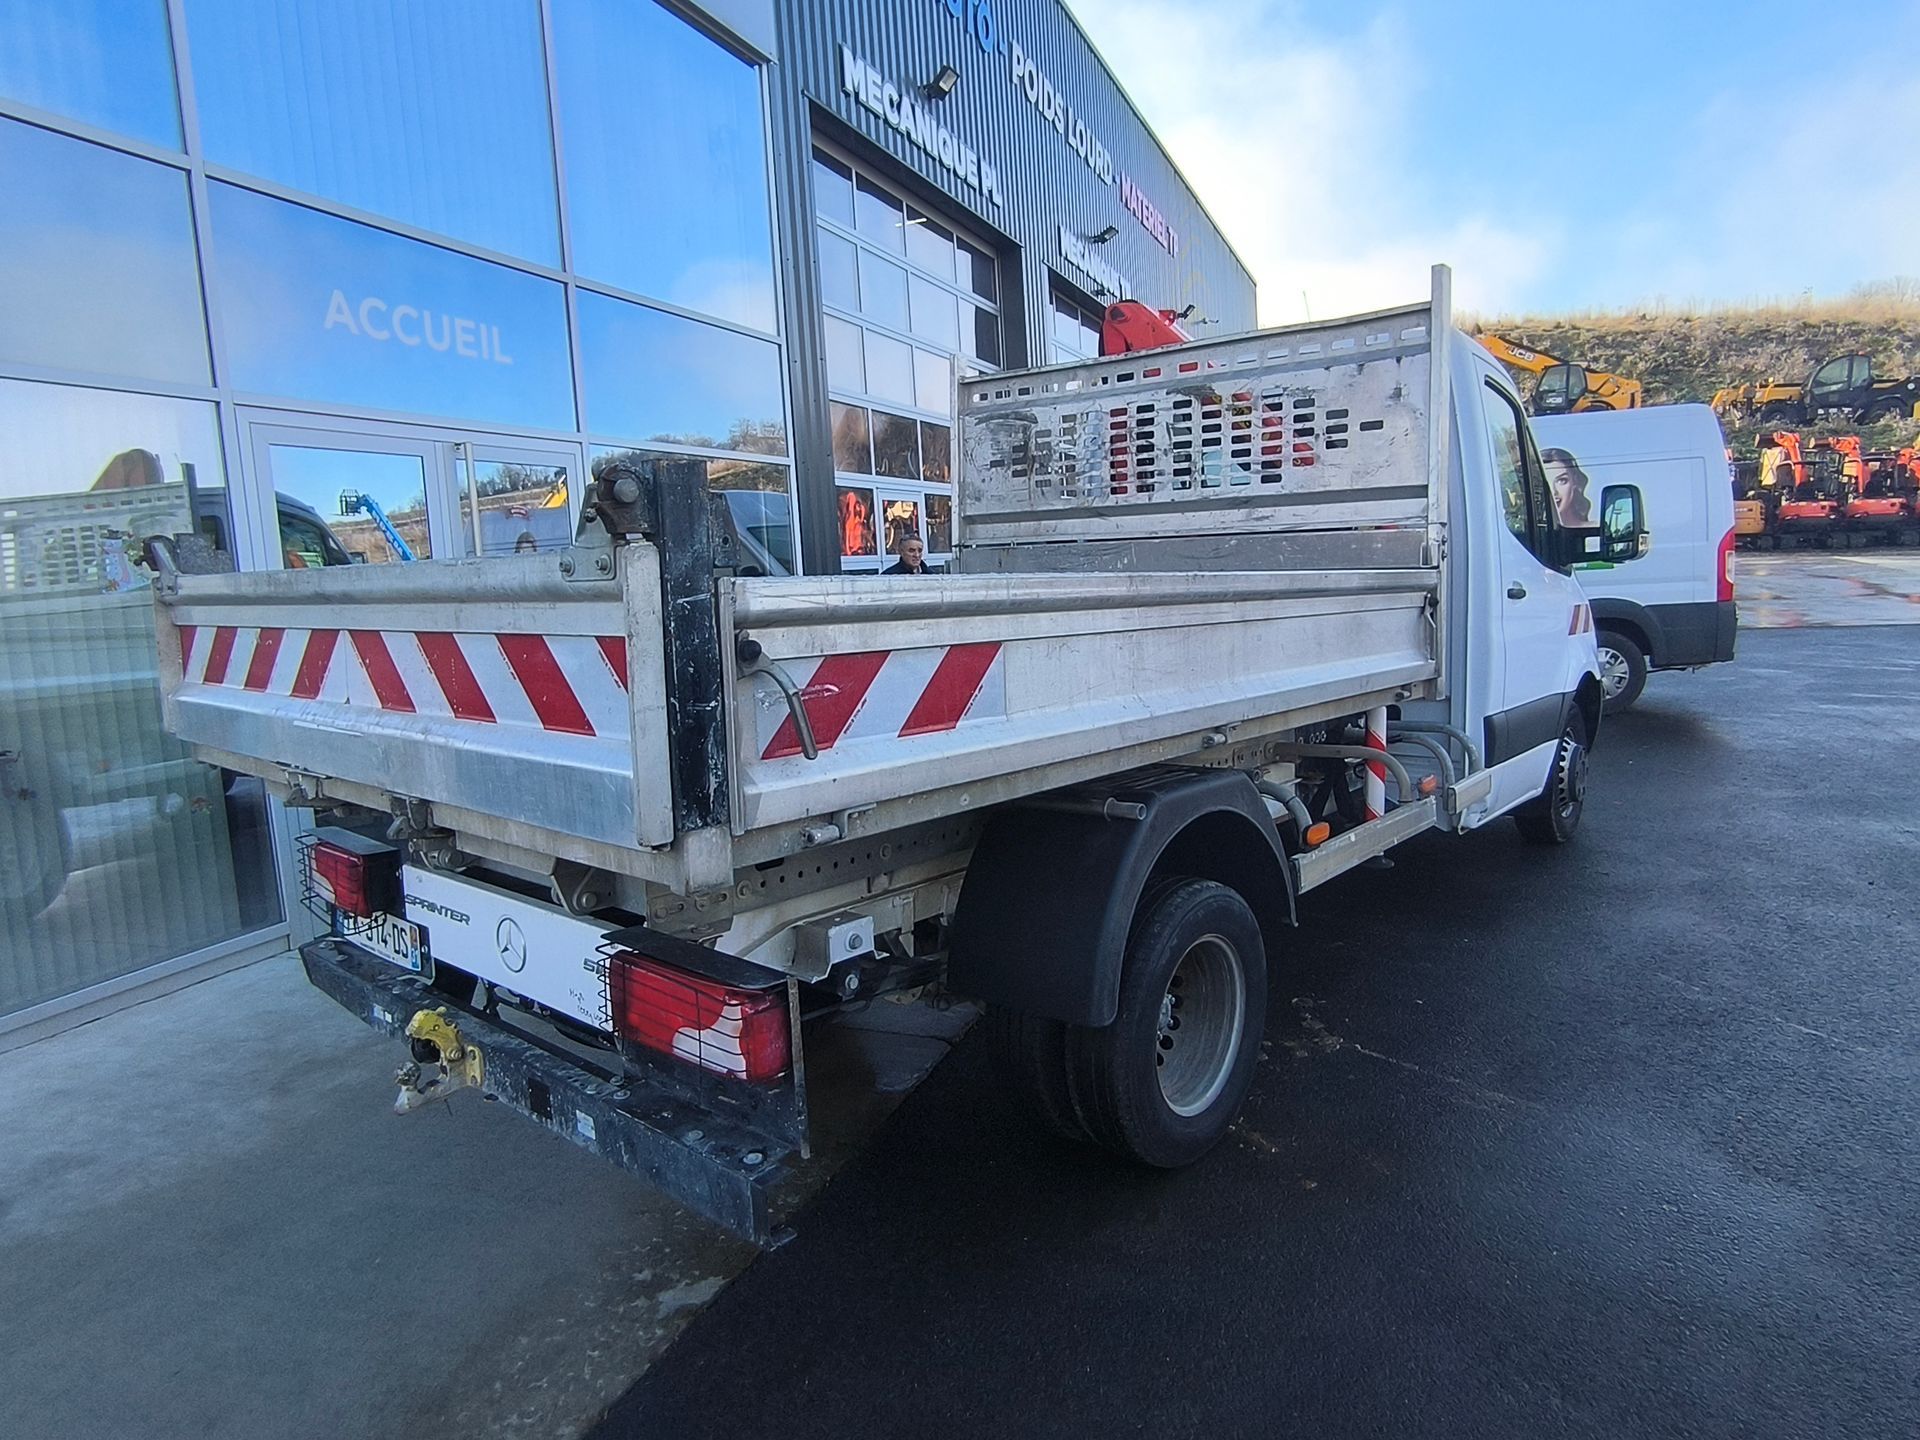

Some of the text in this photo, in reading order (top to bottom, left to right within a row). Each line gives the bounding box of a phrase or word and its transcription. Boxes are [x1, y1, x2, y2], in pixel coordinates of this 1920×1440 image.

[840, 43, 1001, 208] MECANIQUE PL
[1011, 40, 1064, 135] POIDS
[1067, 105, 1113, 187] LOURD
[1120, 169, 1167, 249] MATERIEL
[324, 288, 514, 365] ACCUEIL
[1508, 344, 1535, 362] JCB
[405, 893, 471, 926] SPRINTER
